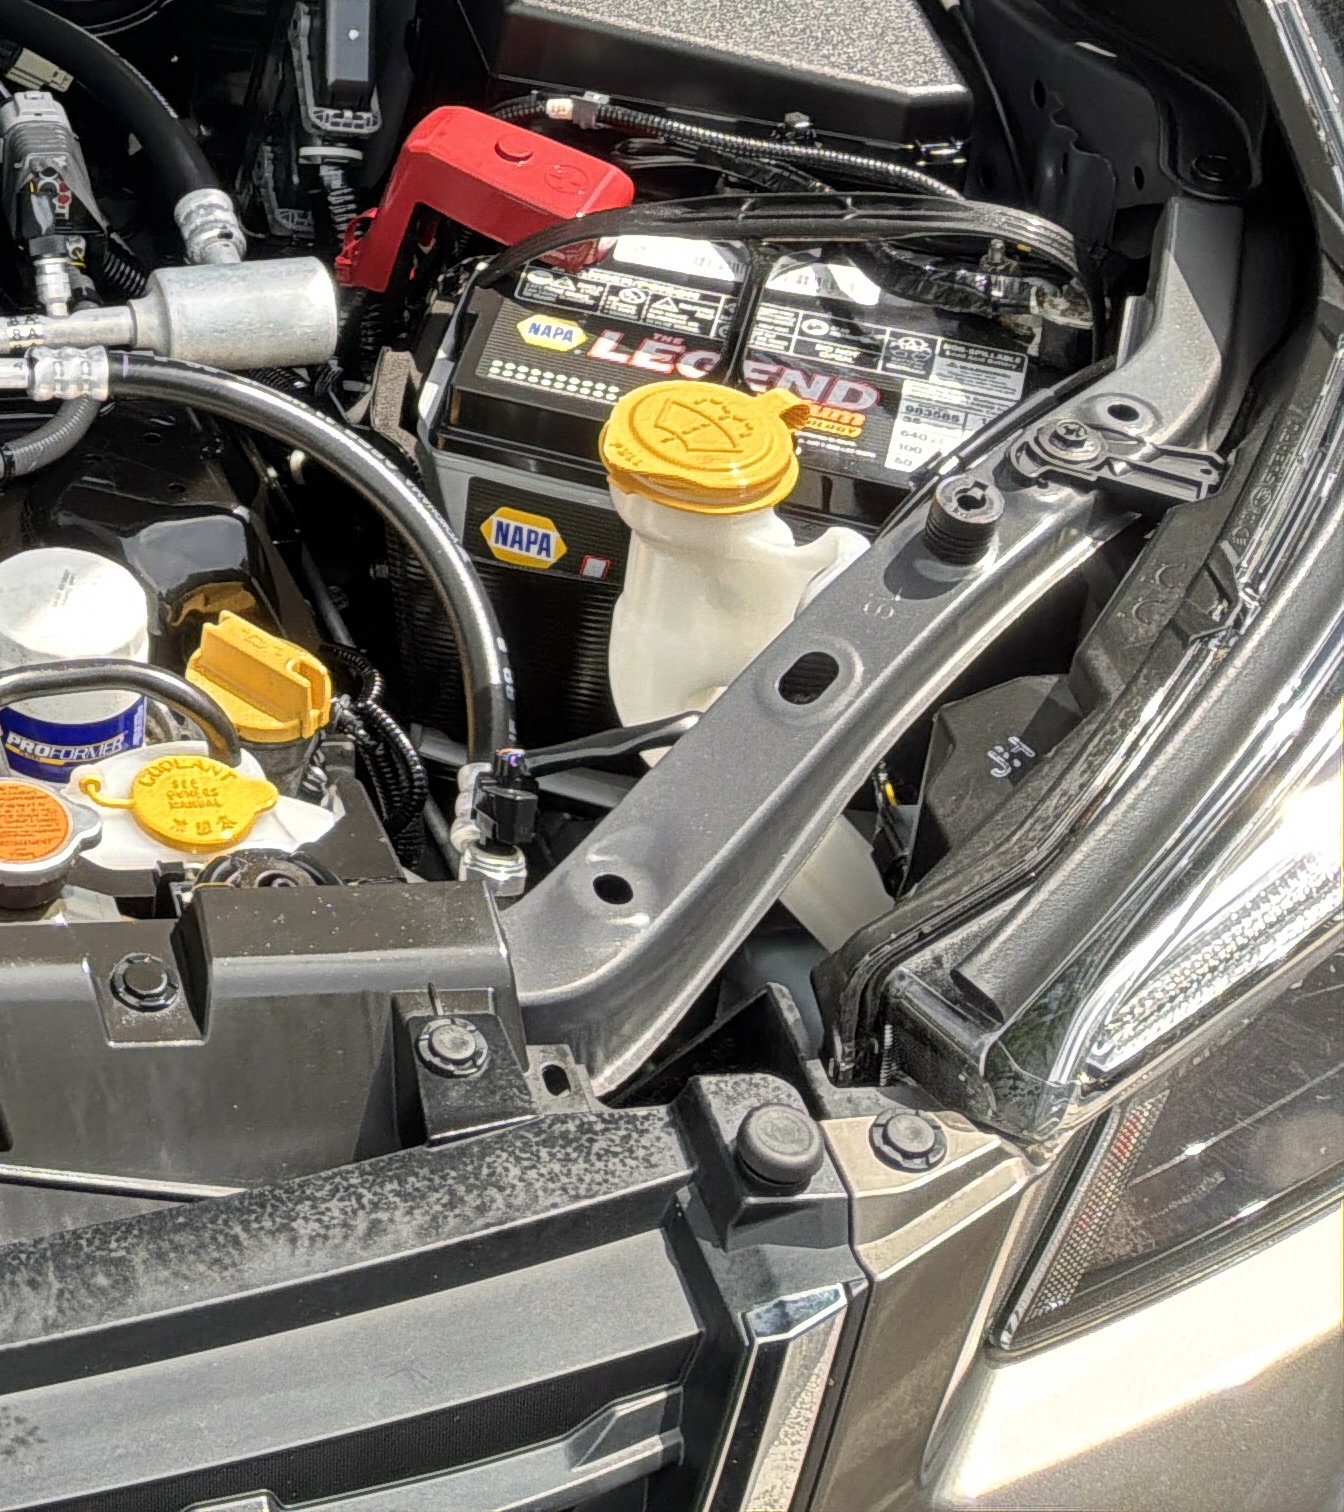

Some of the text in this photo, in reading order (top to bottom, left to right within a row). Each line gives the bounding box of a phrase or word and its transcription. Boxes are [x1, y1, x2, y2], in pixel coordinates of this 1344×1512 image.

[527, 322, 574, 342] NAPA
[652, 332, 684, 345] THE
[494, 520, 552, 558] NAPA
[6, 731, 125, 760] PROFORMER
[138, 758, 237, 787] COOLANT
